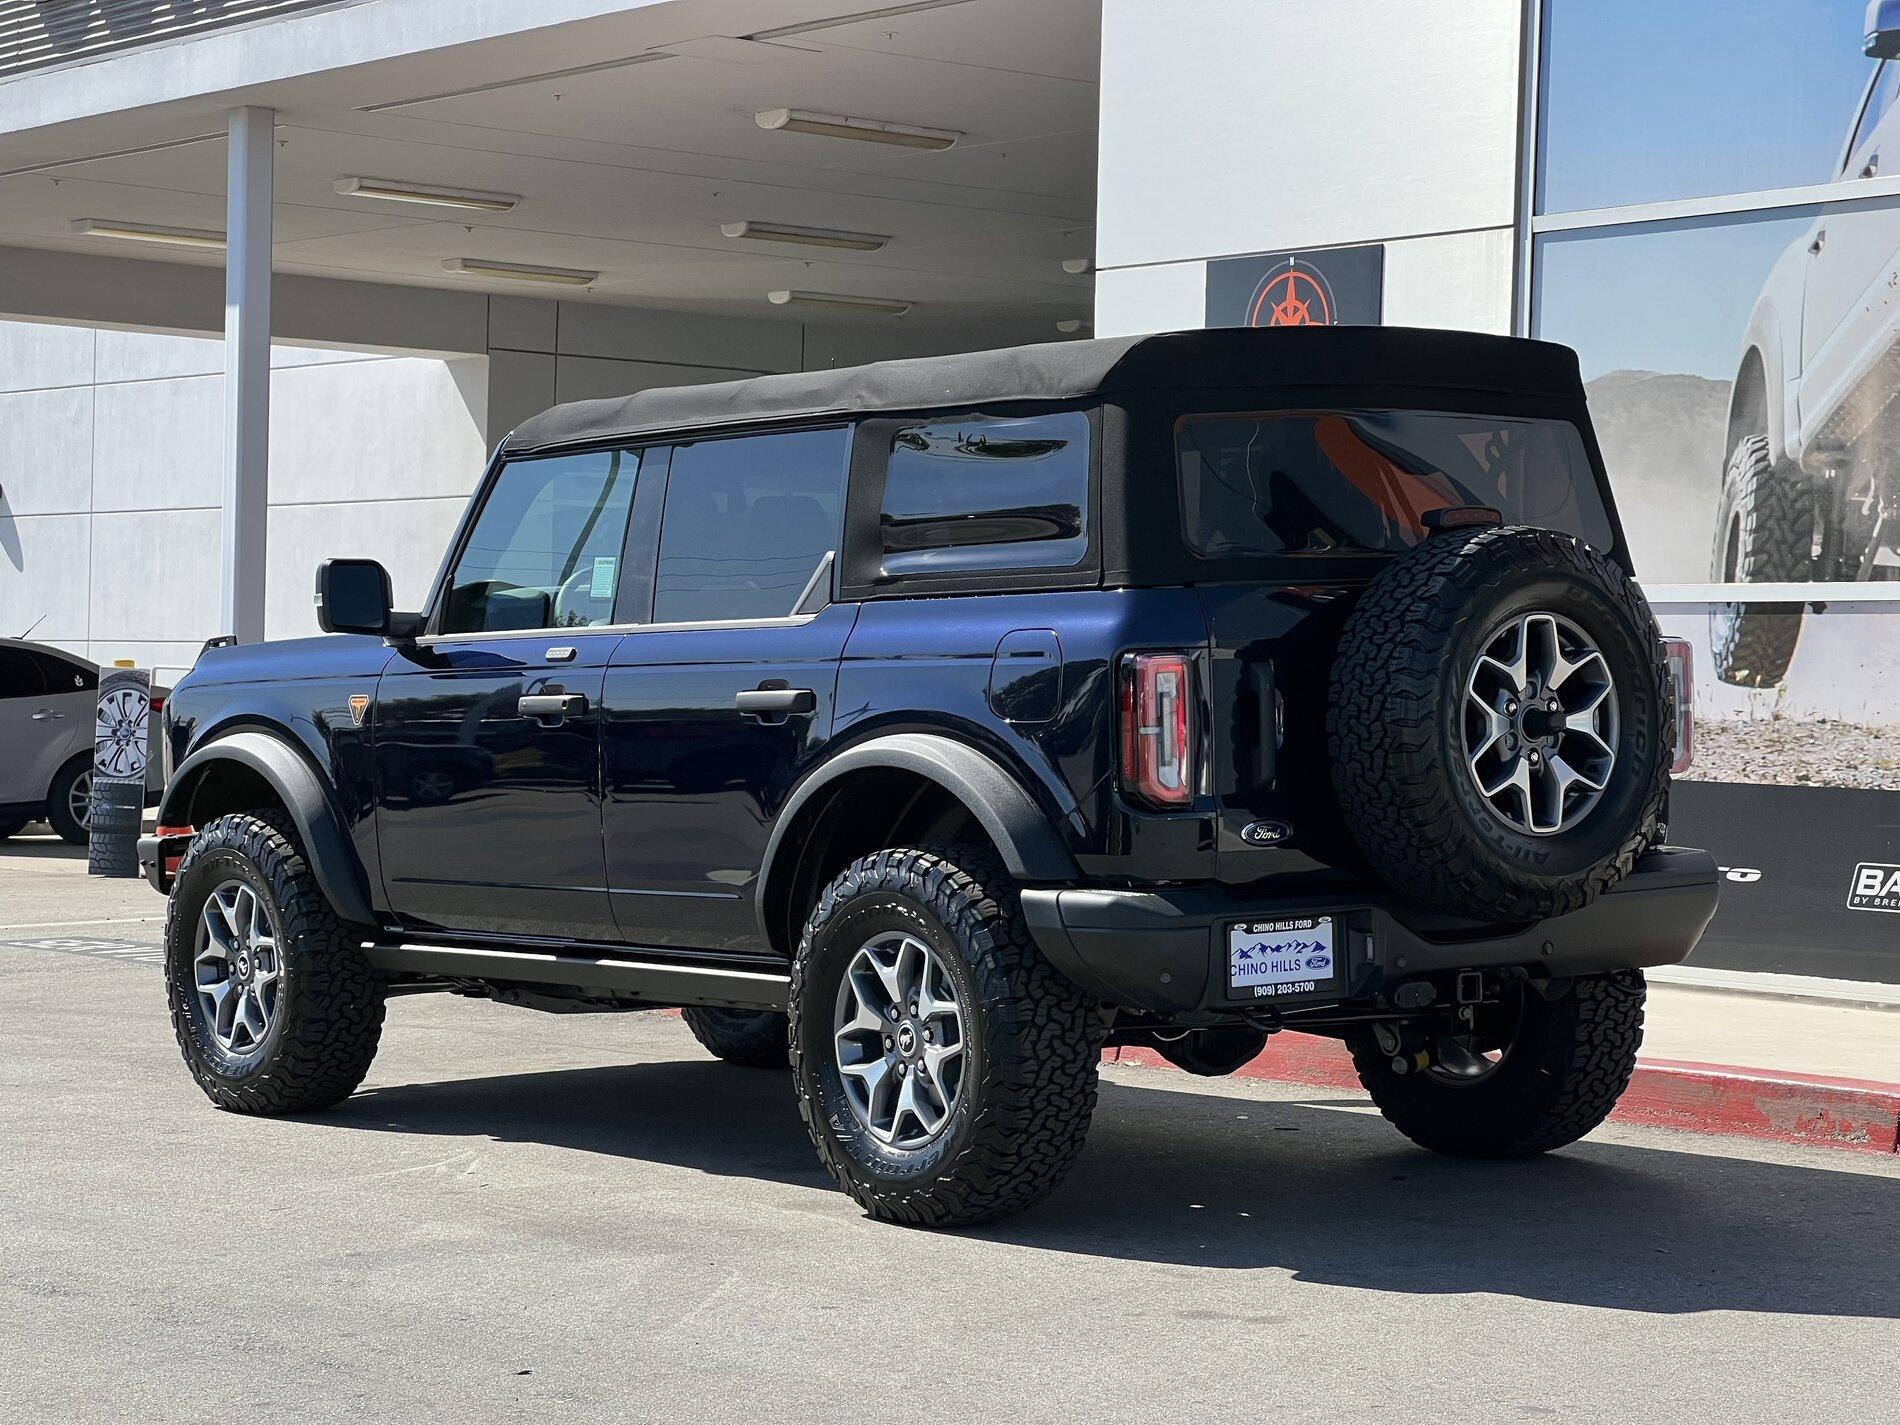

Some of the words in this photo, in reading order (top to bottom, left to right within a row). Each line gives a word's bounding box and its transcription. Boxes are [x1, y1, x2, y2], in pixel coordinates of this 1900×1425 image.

[1254, 825, 1281, 840] Ford
[1853, 896, 1869, 905] BY
[1873, 897, 1900, 907] BRE
[1253, 922, 1274, 933] CHINO
[1275, 920, 1294, 931] HILLS
[1294, 919, 1312, 930] FORD
[1231, 961, 1268, 977] CHINO
[1271, 959, 1301, 973] HILLS
[1254, 985, 1275, 997] (909)
[1277, 981, 1315, 994] 203-5700
